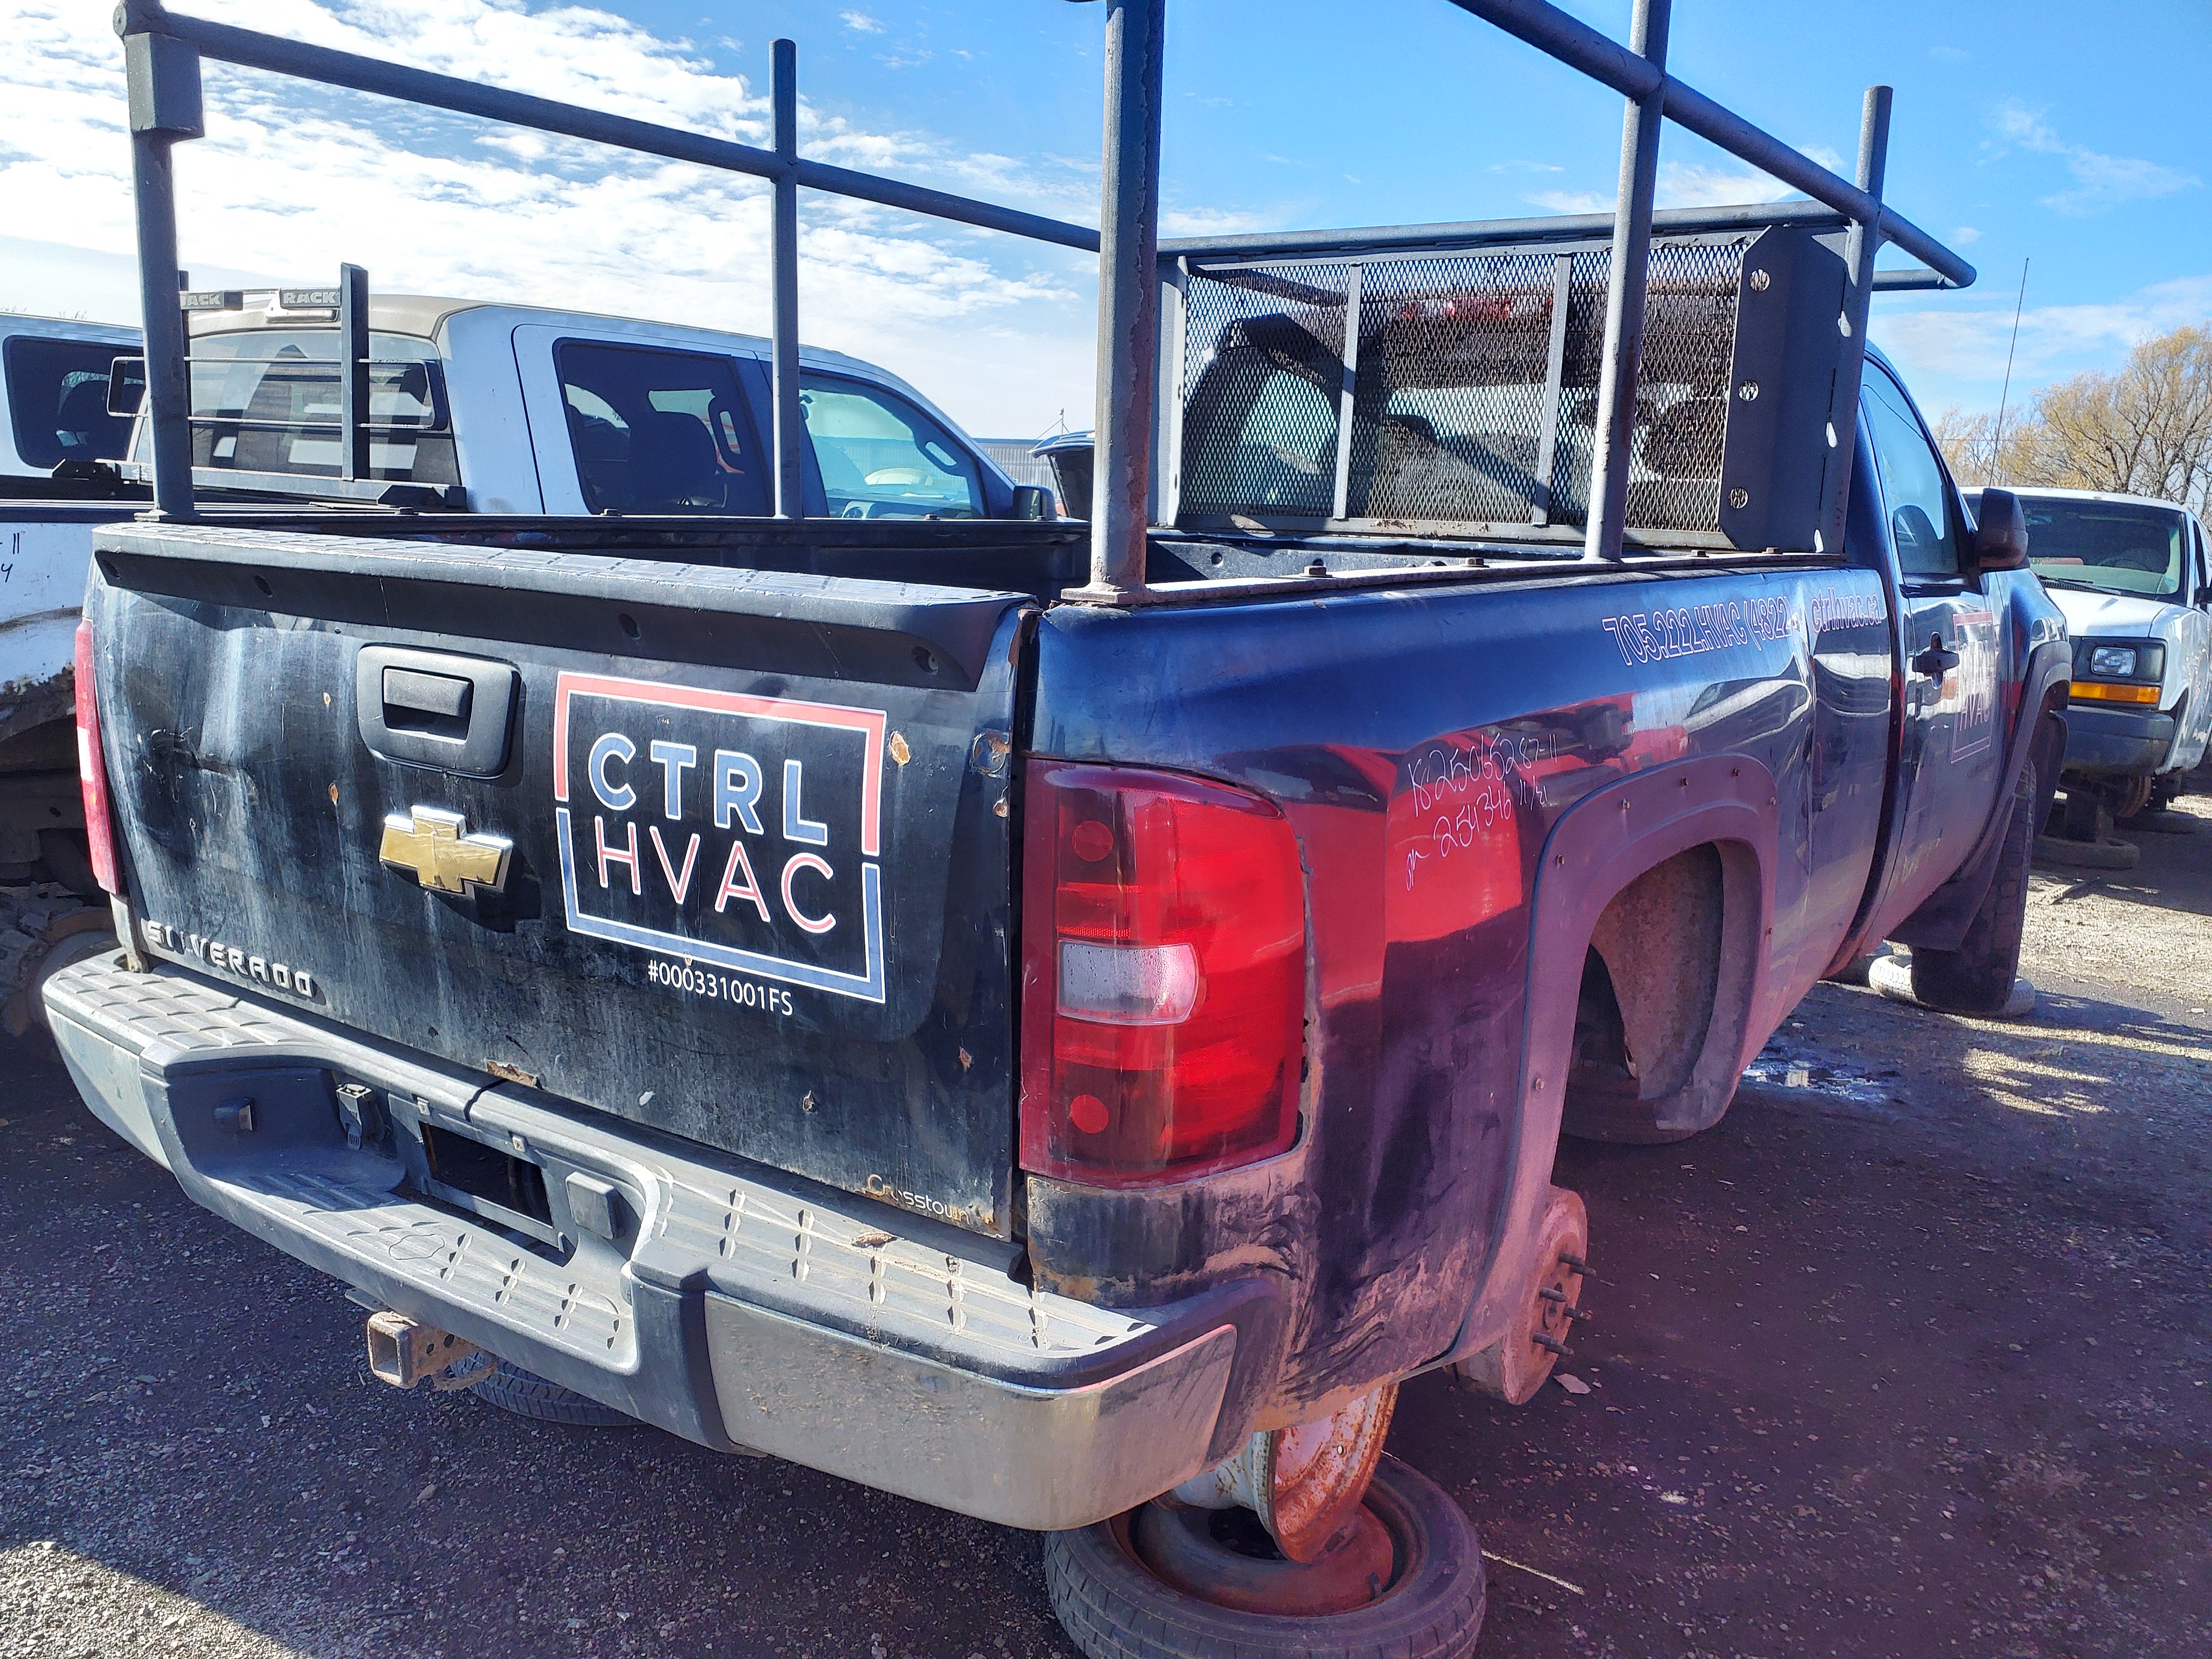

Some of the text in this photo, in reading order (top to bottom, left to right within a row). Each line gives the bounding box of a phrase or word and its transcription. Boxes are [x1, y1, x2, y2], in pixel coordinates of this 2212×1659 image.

[283, 292, 337, 304] RACK
[1602, 602, 1747, 666] 705.222.HVAC
[1811, 587, 1882, 633] ctrlhvac.ca
[588, 732, 828, 847] CTRL
[594, 816, 836, 934] HVAC
[147, 920, 315, 998] SILVERADO
[647, 959, 794, 1016] #000331001FS
